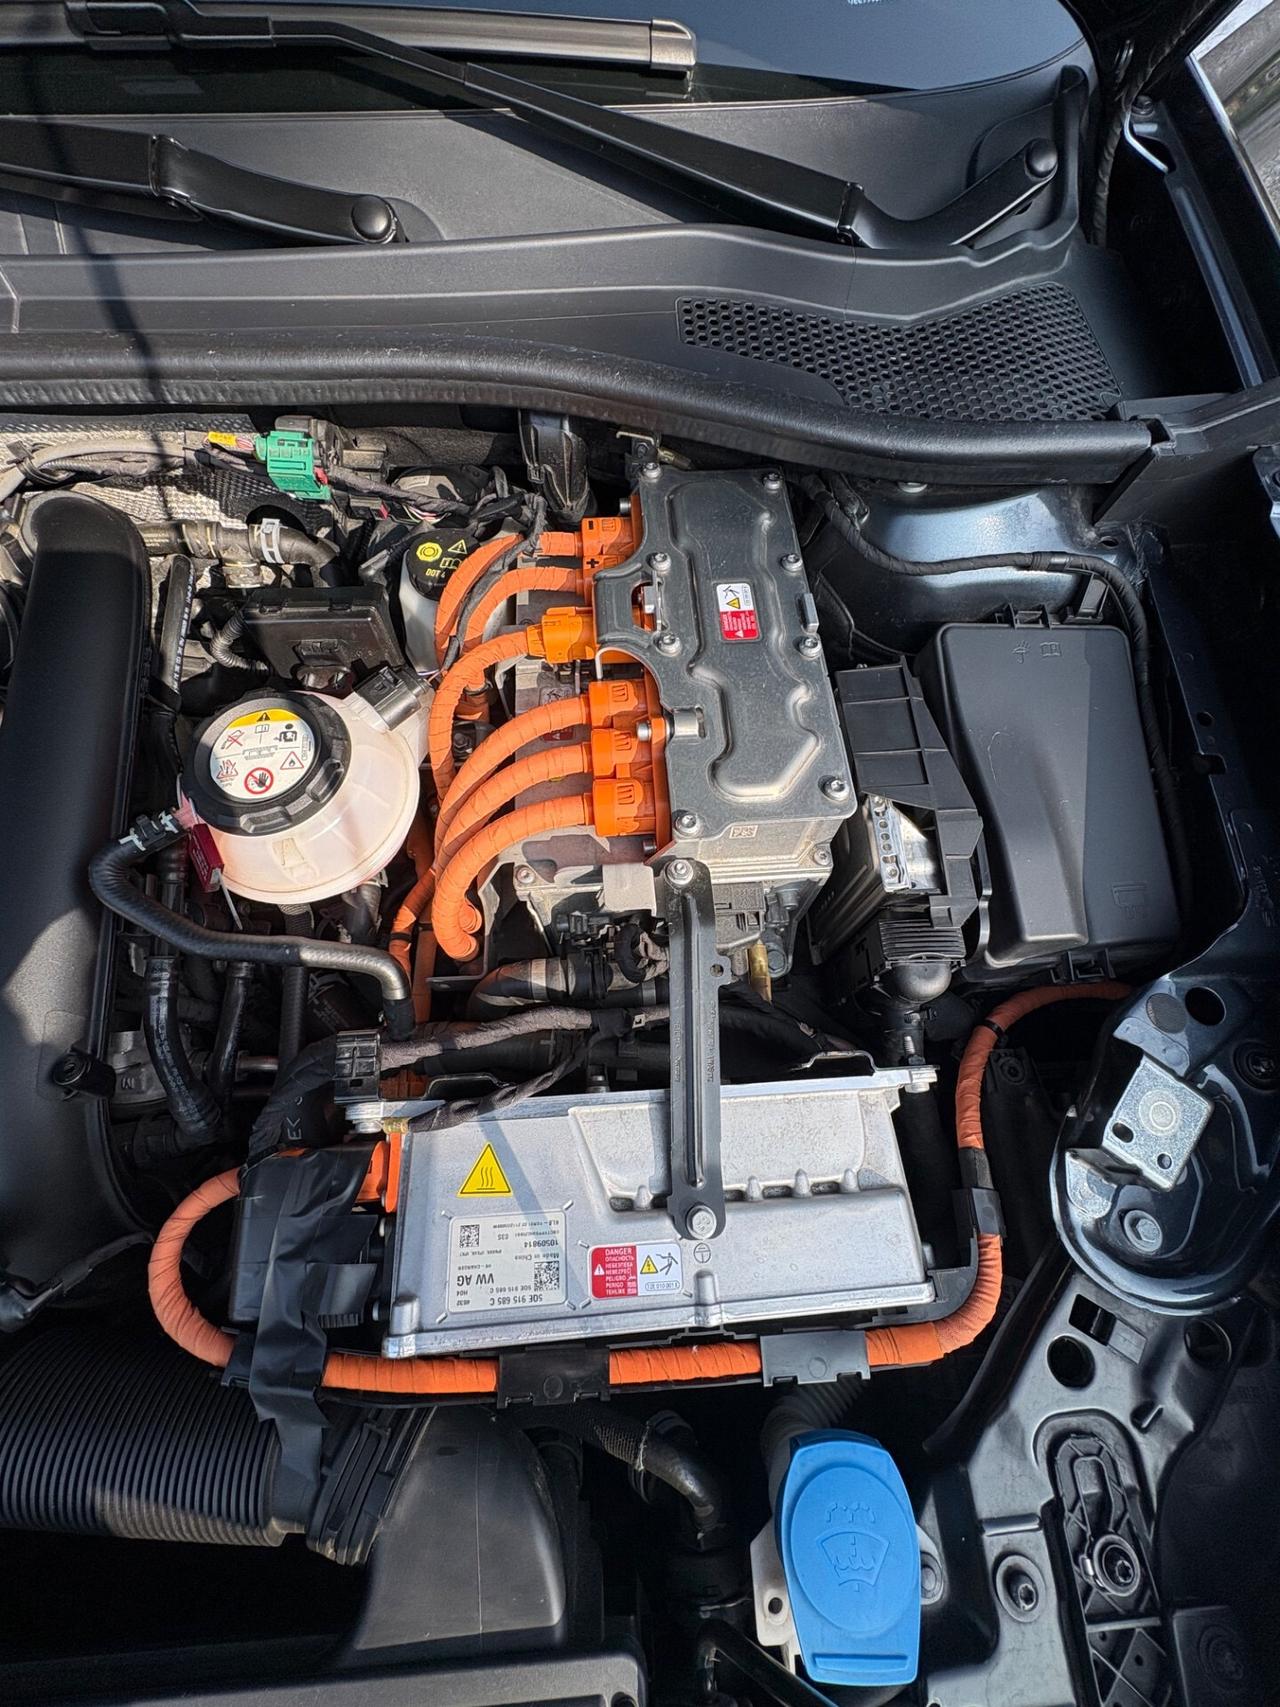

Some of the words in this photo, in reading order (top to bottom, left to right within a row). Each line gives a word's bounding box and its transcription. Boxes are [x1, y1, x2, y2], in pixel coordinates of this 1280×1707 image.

[426, 568, 441, 577] DOT
[457, 1275, 472, 1286] AG
[475, 1273, 494, 1285] VW
[489, 1298, 495, 1306] C
[497, 1297, 510, 1305] 685
[513, 1296, 526, 1304] 915
